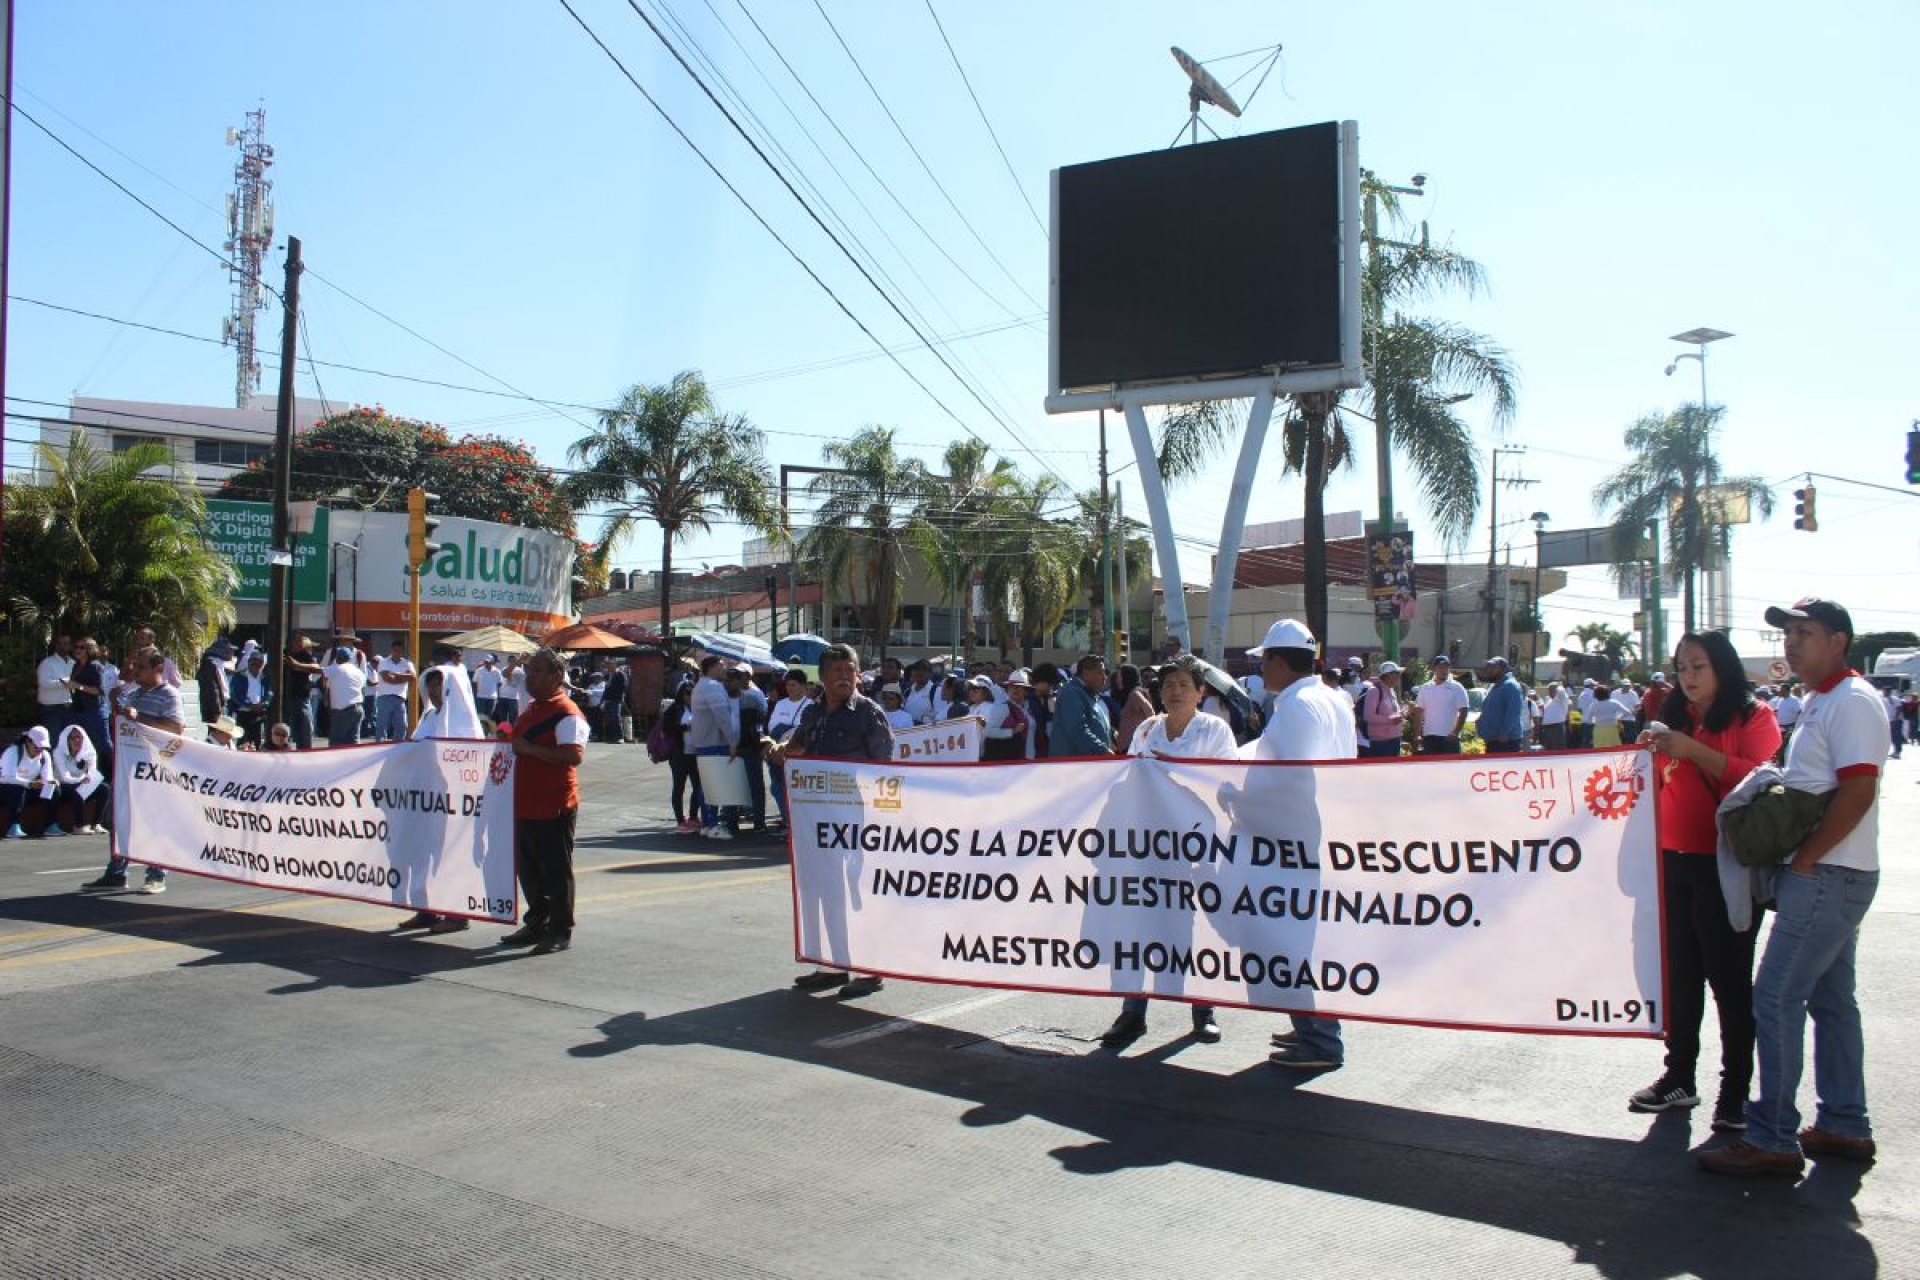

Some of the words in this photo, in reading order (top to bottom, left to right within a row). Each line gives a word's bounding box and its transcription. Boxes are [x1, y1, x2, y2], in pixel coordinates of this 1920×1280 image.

[226, 523, 272, 538] Digita
[430, 583, 466, 598] salud
[472, 588, 486, 599] es
[401, 610, 460, 623] Loratorio
[443, 749, 477, 764] CECATI
[461, 769, 479, 783] 100
[875, 775, 899, 797] 19
[1469, 769, 1555, 792] CECATI
[200, 777, 218, 796] EL
[220, 782, 267, 802] PAGO
[266, 787, 345, 808] INTEGRO
[350, 788, 363, 808] Y
[371, 789, 456, 815] PUNTUAL
[462, 794, 483, 817] DE
[204, 806, 272, 833] NUESTRO
[1528, 800, 1556, 820] 57
[816, 821, 960, 856] EXIGIMOS
[969, 829, 1007, 857] LA
[1016, 822, 1238, 863] DEVOLUCIÓN
[1251, 836, 1320, 870] DEL
[1328, 836, 1582, 873] DESCUENTO
[201, 842, 270, 873] MAESTRO
[274, 855, 401, 889] HOMOLOGADO
[872, 868, 1019, 902] INDEBIDO
[1029, 875, 1053, 903] A
[1065, 875, 1222, 913] NUESTRO
[1232, 884, 1481, 928] AGUINALDO.
[941, 932, 1100, 970] MAESTRO
[1114, 941, 1380, 996] HOMOLOGADO
